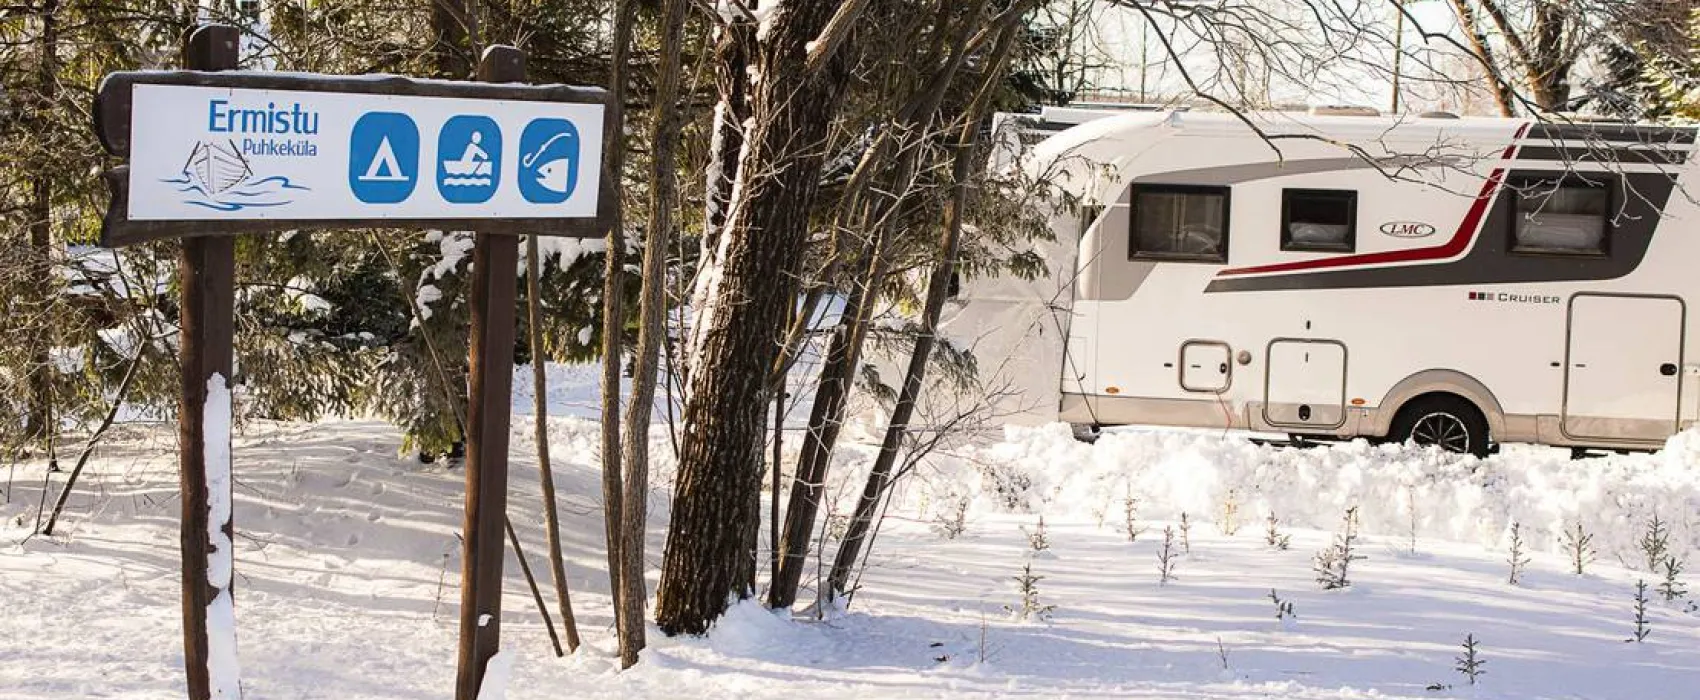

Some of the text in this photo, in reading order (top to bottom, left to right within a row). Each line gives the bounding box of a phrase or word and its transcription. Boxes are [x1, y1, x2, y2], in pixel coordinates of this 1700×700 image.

[208, 100, 318, 135] Ermistu
[243, 138, 317, 157] Puhkeküla
[1389, 224, 1425, 235] LMC
